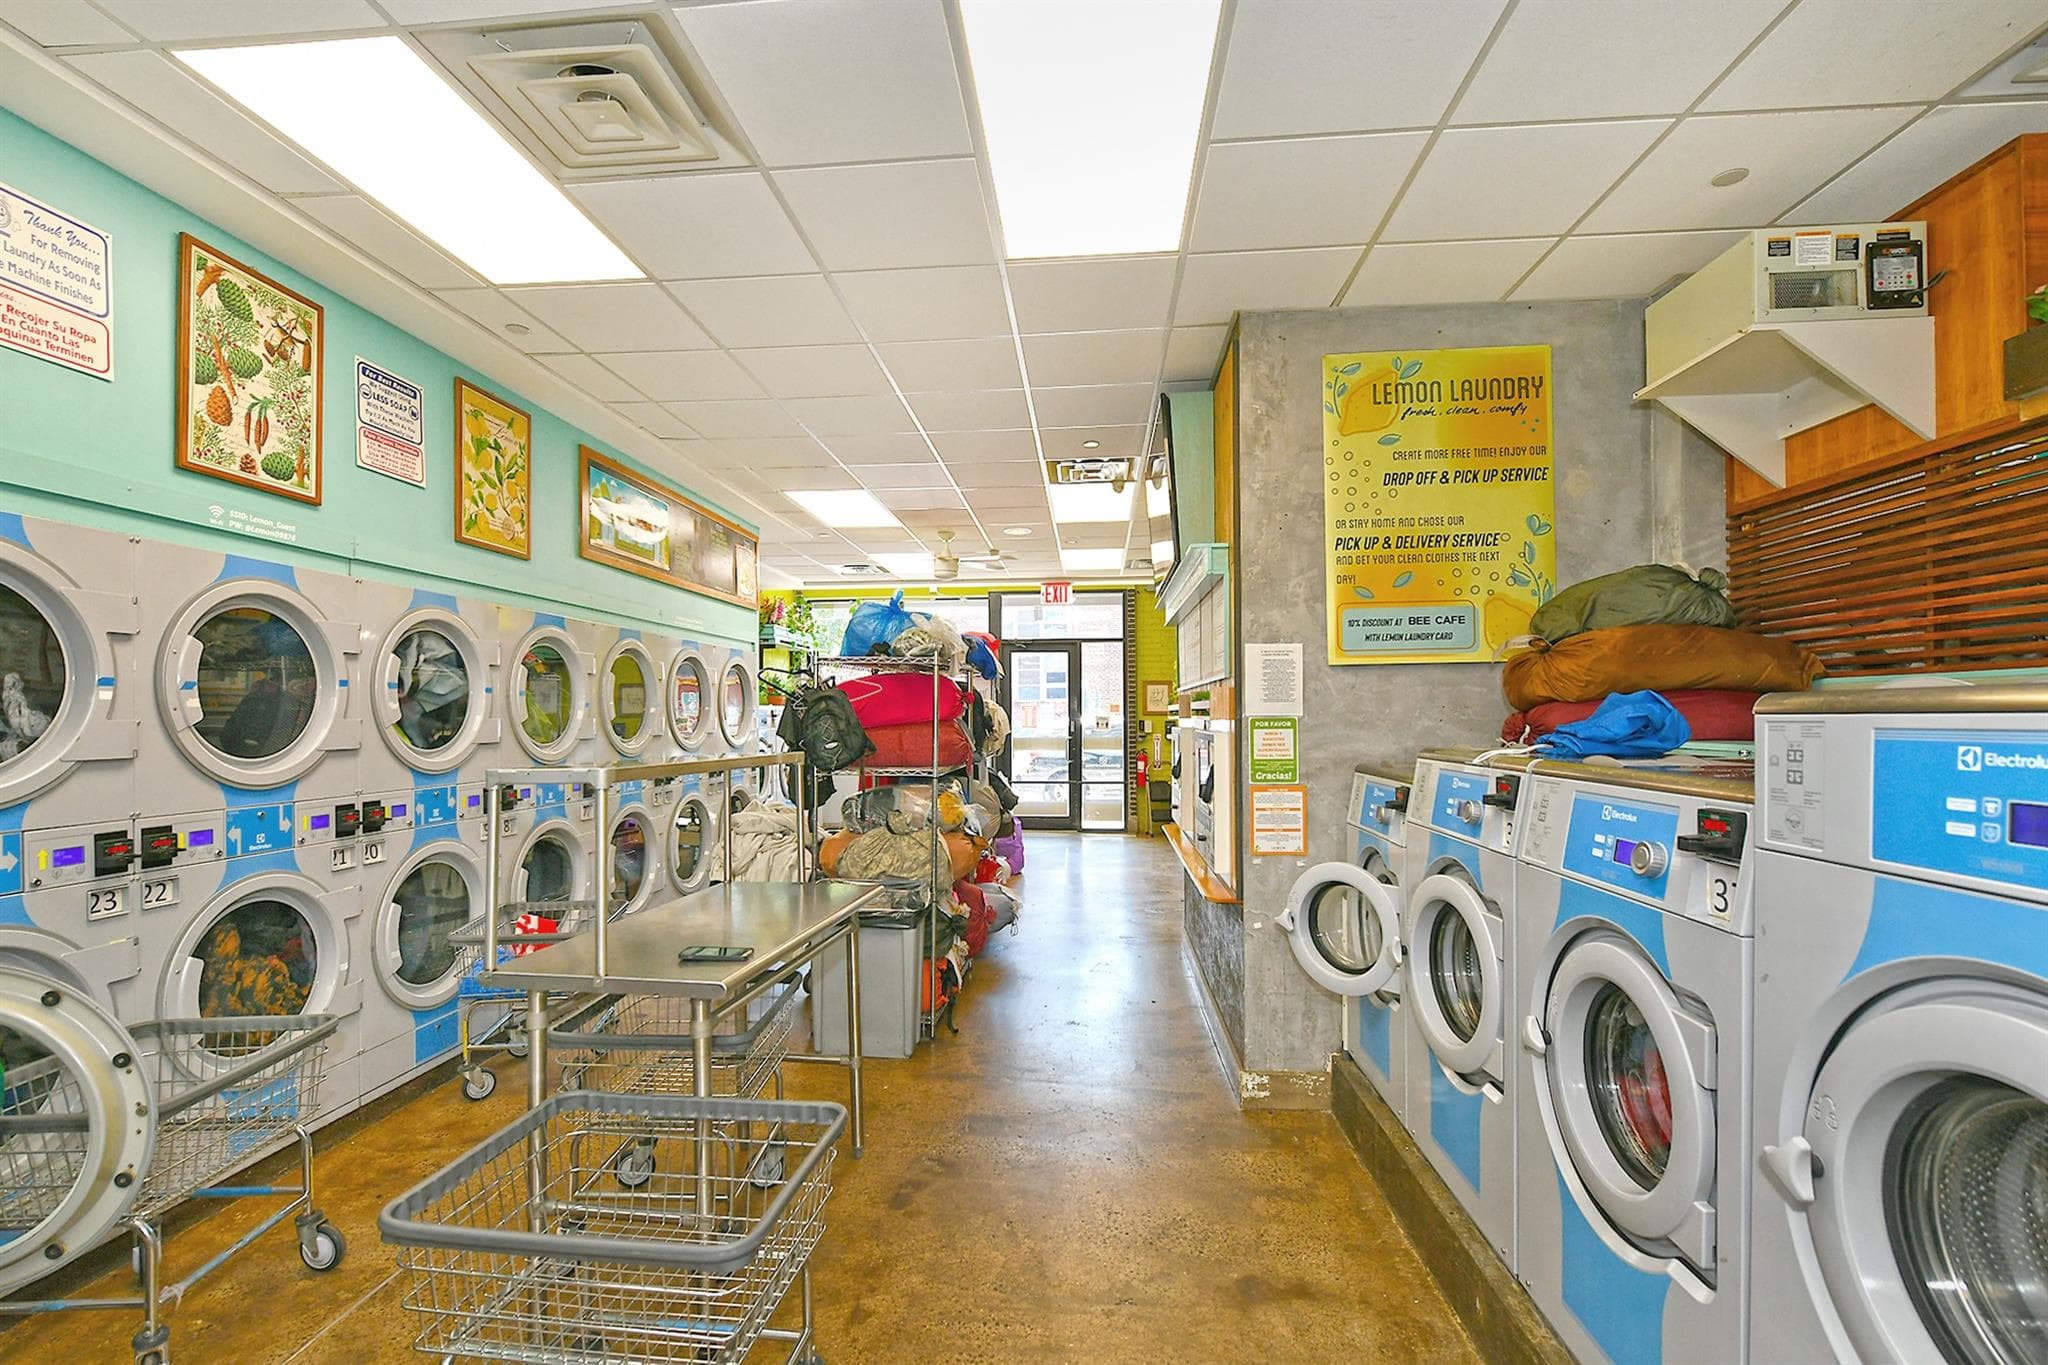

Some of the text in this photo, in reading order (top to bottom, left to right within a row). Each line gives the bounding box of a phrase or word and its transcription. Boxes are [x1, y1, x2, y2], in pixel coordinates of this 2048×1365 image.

[24, 210, 62, 238] Thank
[31, 234, 100, 275] For Removing
[4, 240, 46, 270] Laundry
[48, 260, 60, 273] As
[62, 266, 87, 285] Soon
[89, 278, 100, 290] As
[8, 261, 51, 288] Machine
[55, 280, 93, 304] Finishes
[1, 314, 79, 348] En Cuanto Las
[7, 304, 96, 344] Recojer Su Ropa
[44, 340, 94, 364] Terminen
[1373, 376, 1543, 405] LEMON LAUNDRY
[373, 392, 407, 412] LESS SOAP
[1489, 402, 1527, 416] comfy
[1392, 445, 1547, 461] CREATE MORE FREE TIME! ENJOY OUR
[1383, 467, 1549, 486] DROP OFF & PICK UP SERVICE
[1336, 516, 1464, 529] OR STAY HOME AND CHOSE OUR
[1335, 532, 1500, 551] PICK UP & DELIVERY SERVICE
[1336, 551, 1500, 565] AND GET YOUR CLEAN CLOTHES THE NEXT
[1336, 574, 1356, 585] DAY!
[1045, 584, 1069, 603] EXIT
[1362, 618, 1392, 627] DISCOUNT
[1394, 618, 1403, 626] AT
[1408, 616, 1431, 625] BEE
[1435, 615, 1466, 625] CAFE
[1364, 632, 1454, 642] WITH LEMON LAUNDRY CARD
[1256, 771, 1292, 780] Gracias!
[1612, 810, 1638, 822] Electrolux
[90, 890, 117, 914] 23
[145, 882, 167, 904] 22
[1714, 878, 1729, 913] 3
